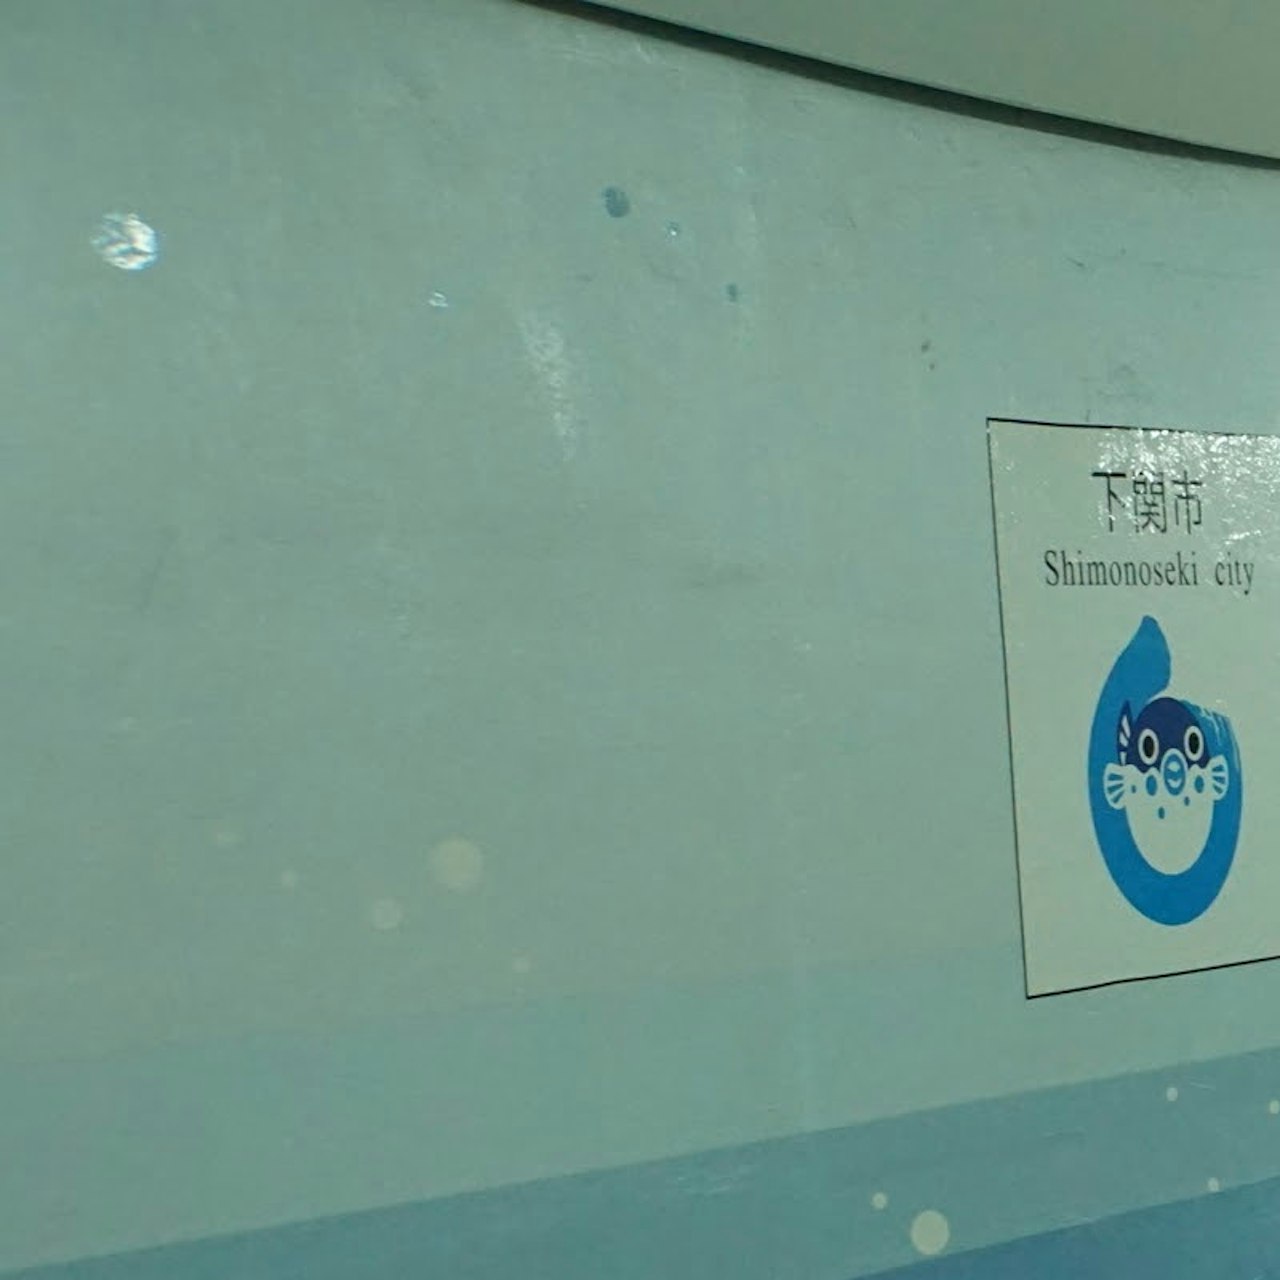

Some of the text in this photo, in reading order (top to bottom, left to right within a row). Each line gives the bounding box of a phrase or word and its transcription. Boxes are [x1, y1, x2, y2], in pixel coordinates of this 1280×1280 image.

[1091, 469, 1203, 535] 下関市
[1043, 549, 1255, 596] Shimonoseki city
